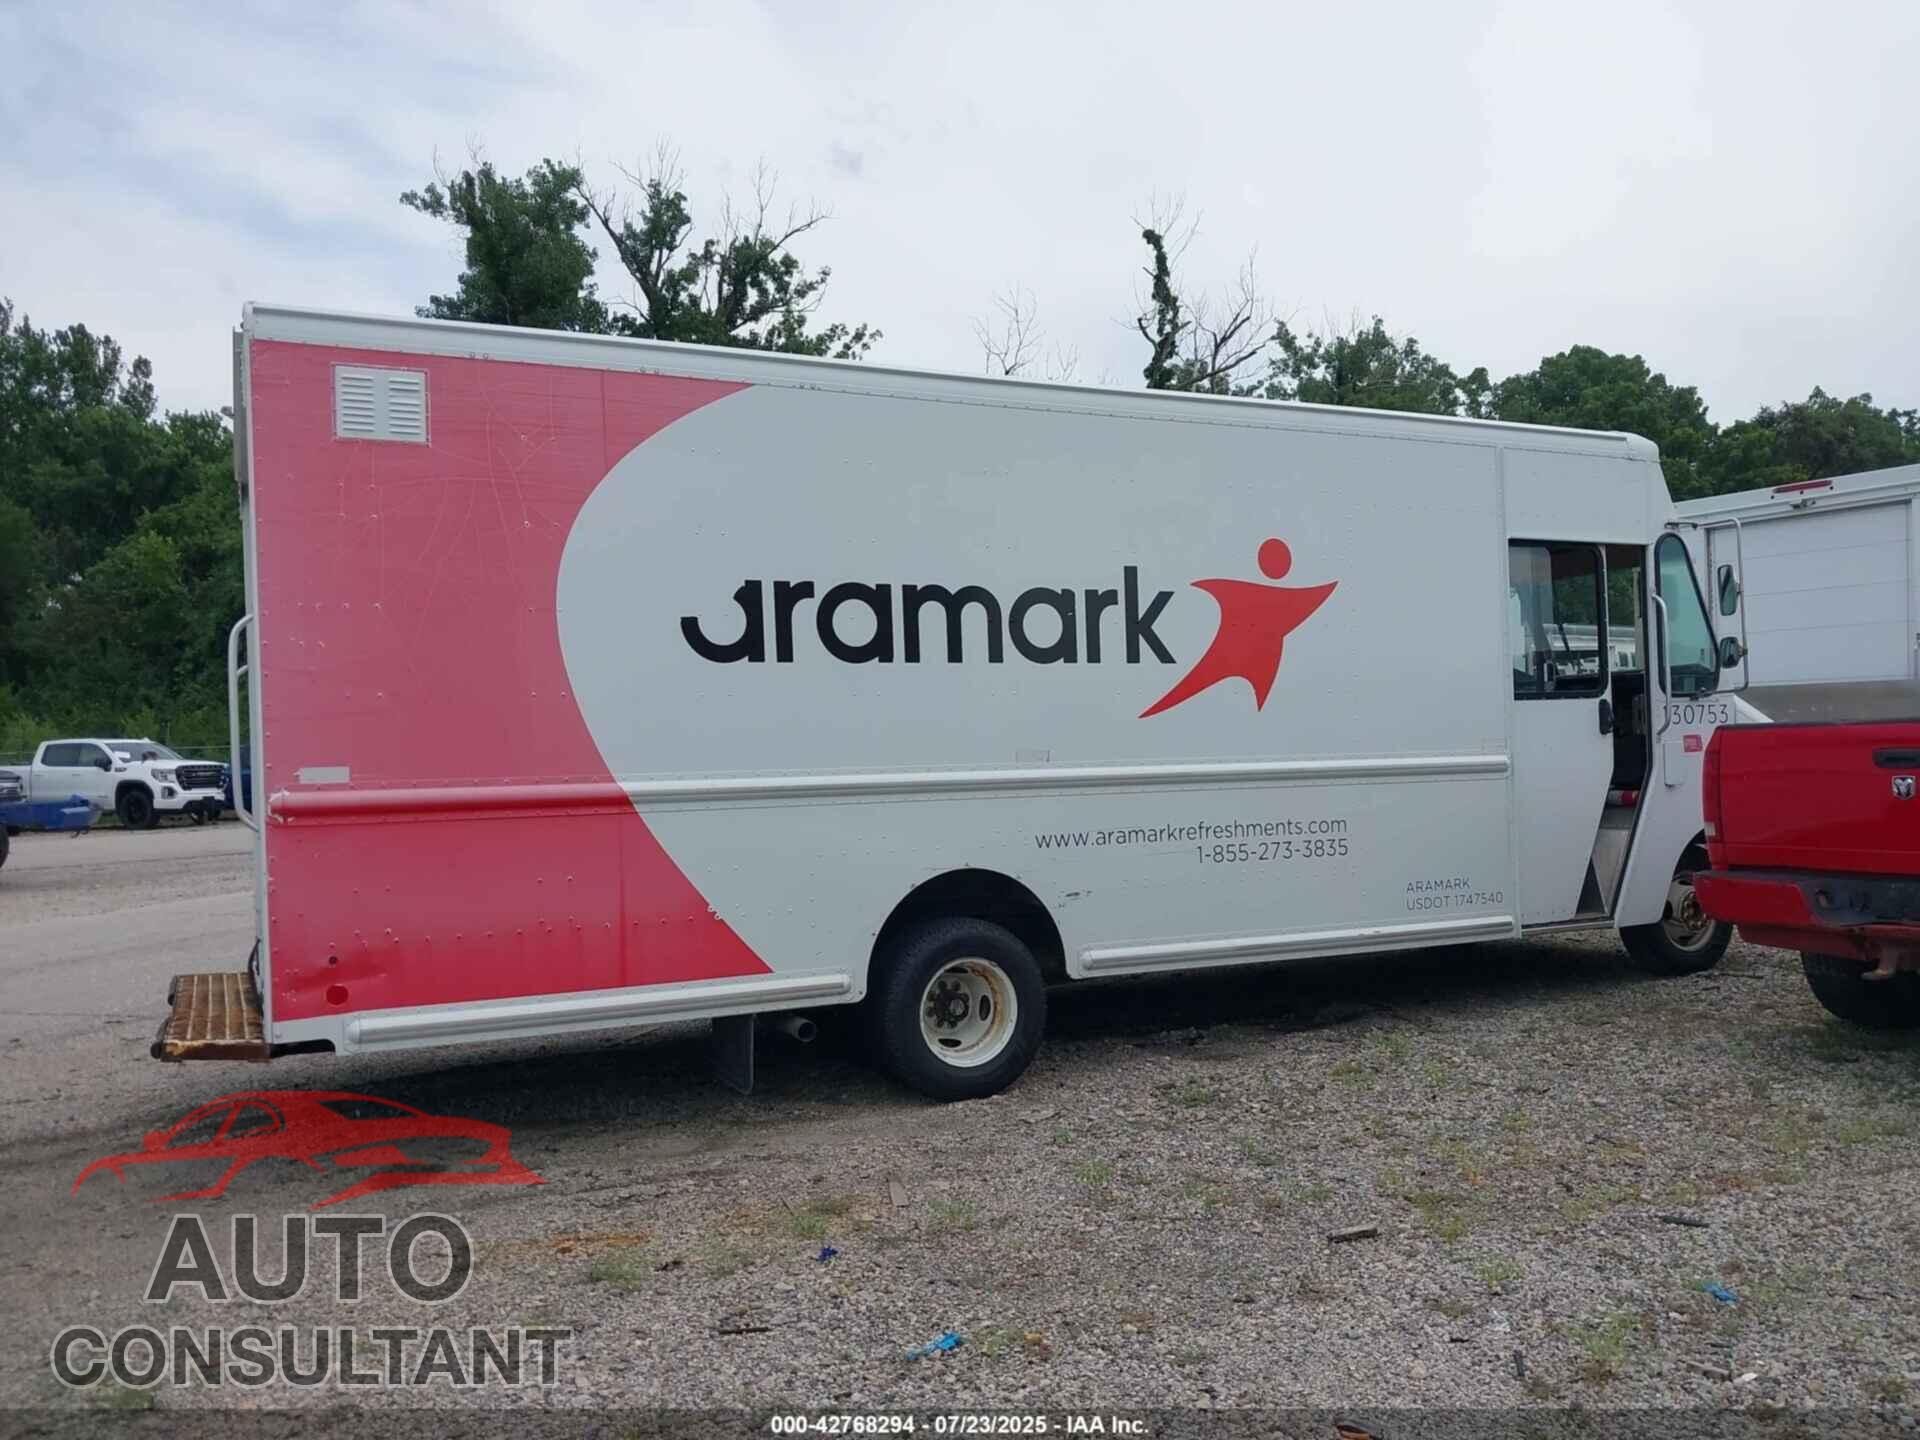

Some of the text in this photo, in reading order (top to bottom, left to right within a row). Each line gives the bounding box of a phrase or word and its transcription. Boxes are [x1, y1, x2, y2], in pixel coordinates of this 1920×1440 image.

[680, 565, 1177, 665] aramark
[1035, 816, 1348, 850] www.aramarkrefreshments.com
[1196, 838, 1349, 865] 1-855-273-3835
[1406, 877, 1471, 894] ARAMARK
[1406, 891, 1504, 911] USDOT 1747540
